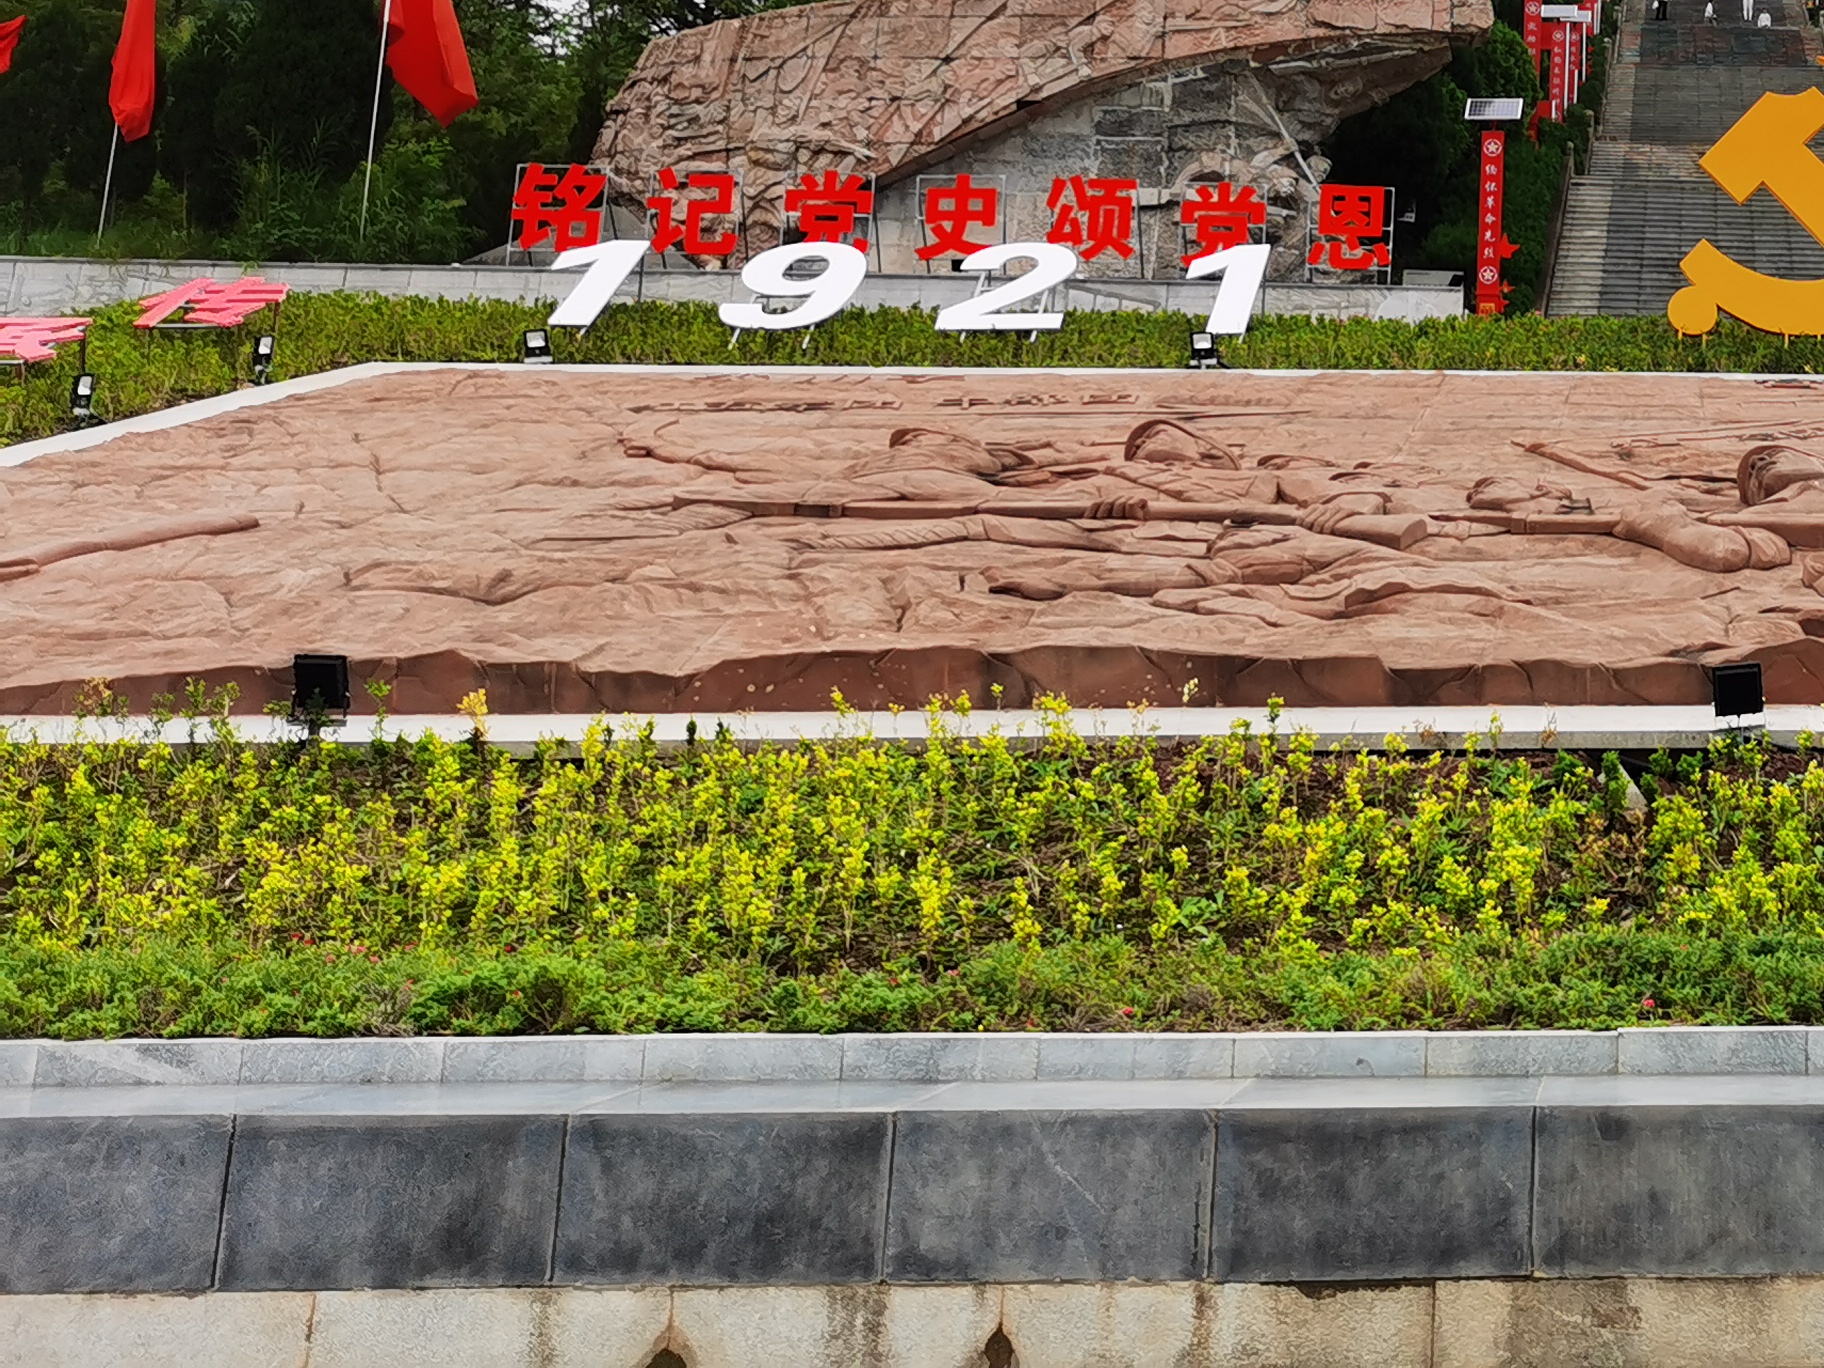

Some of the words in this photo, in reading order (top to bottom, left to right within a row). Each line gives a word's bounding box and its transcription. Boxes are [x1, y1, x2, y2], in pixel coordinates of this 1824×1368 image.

[512, 162, 1391, 270] 铭记党史颂党恩
[1482, 163, 1499, 260] 缅怀革命先烈
[546, 239, 1271, 335] 1921
